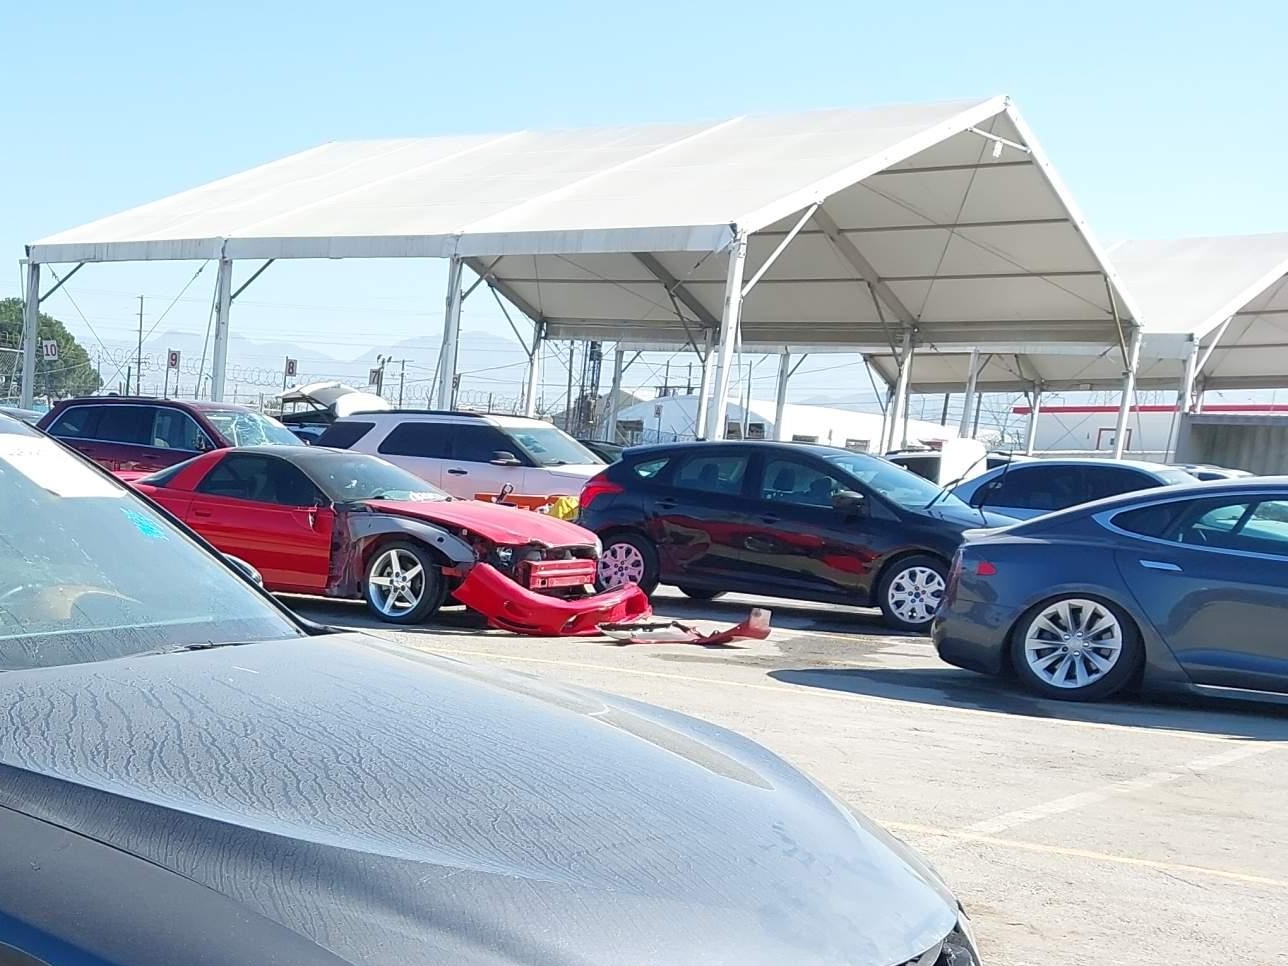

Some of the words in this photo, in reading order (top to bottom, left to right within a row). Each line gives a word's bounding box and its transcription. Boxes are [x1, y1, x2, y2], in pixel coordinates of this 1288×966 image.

[43, 343, 57, 357] 10
[170, 352, 178, 367] 9
[287, 361, 295, 375] 8
[372, 370, 379, 384] 7
